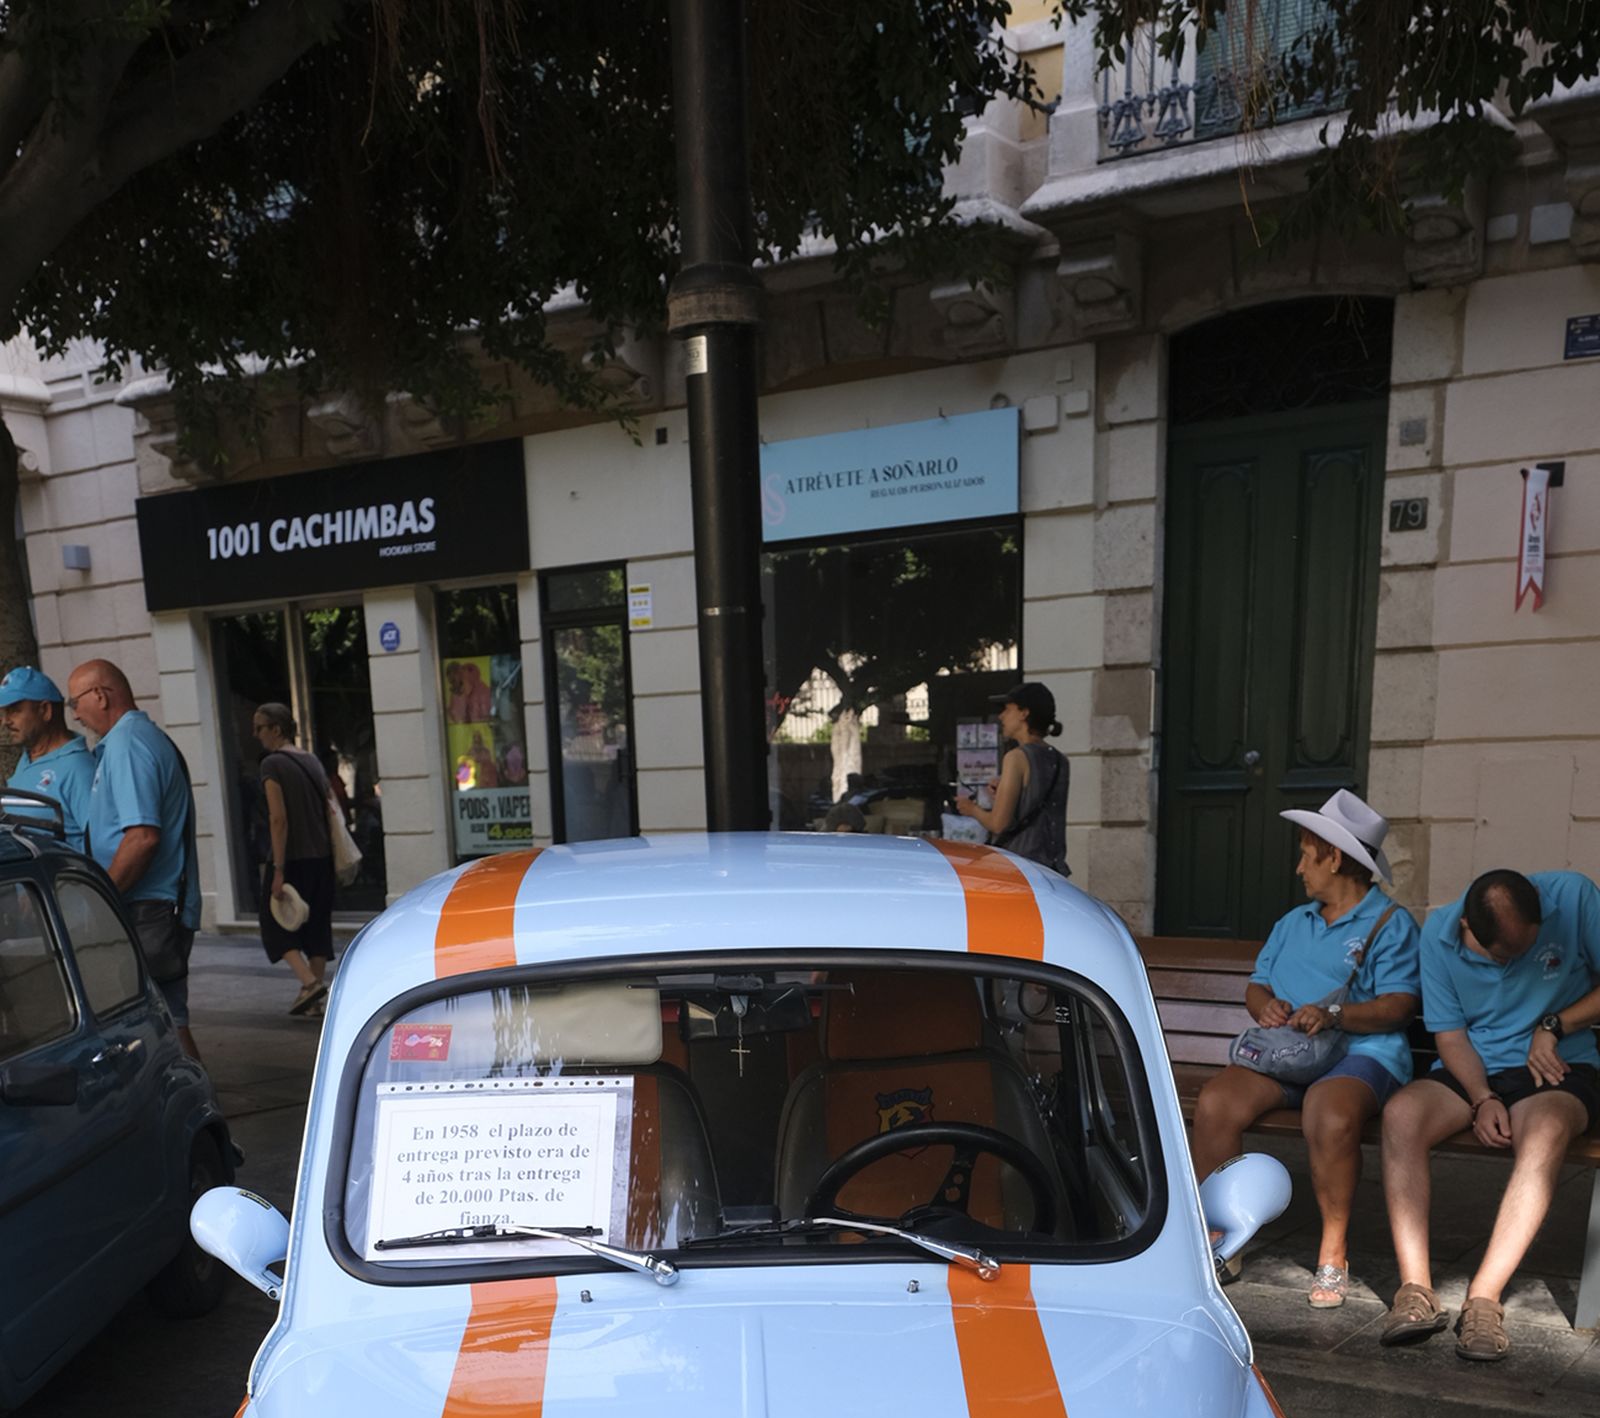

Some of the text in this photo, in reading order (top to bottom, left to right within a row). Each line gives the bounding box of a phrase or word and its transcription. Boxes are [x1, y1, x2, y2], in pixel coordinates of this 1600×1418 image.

[868, 468, 879, 484] A
[883, 457, 958, 482] SOÑARLO
[870, 476, 985, 499] REGALOS PERSONALIZADOS
[1392, 500, 1422, 528] 79
[207, 498, 436, 560] 1001 CACHIMBAS
[414, 541, 436, 553] STORE
[459, 796, 490, 819] PODS
[413, 1122, 578, 1144] En 1958 el plazo de
[397, 1144, 590, 1164] entrega previsto era de
[402, 1167, 581, 1184] 4 años tras la entrega
[415, 1188, 565, 1205] de 20.000 Ptas. de
[460, 1210, 515, 1225] fianza.
